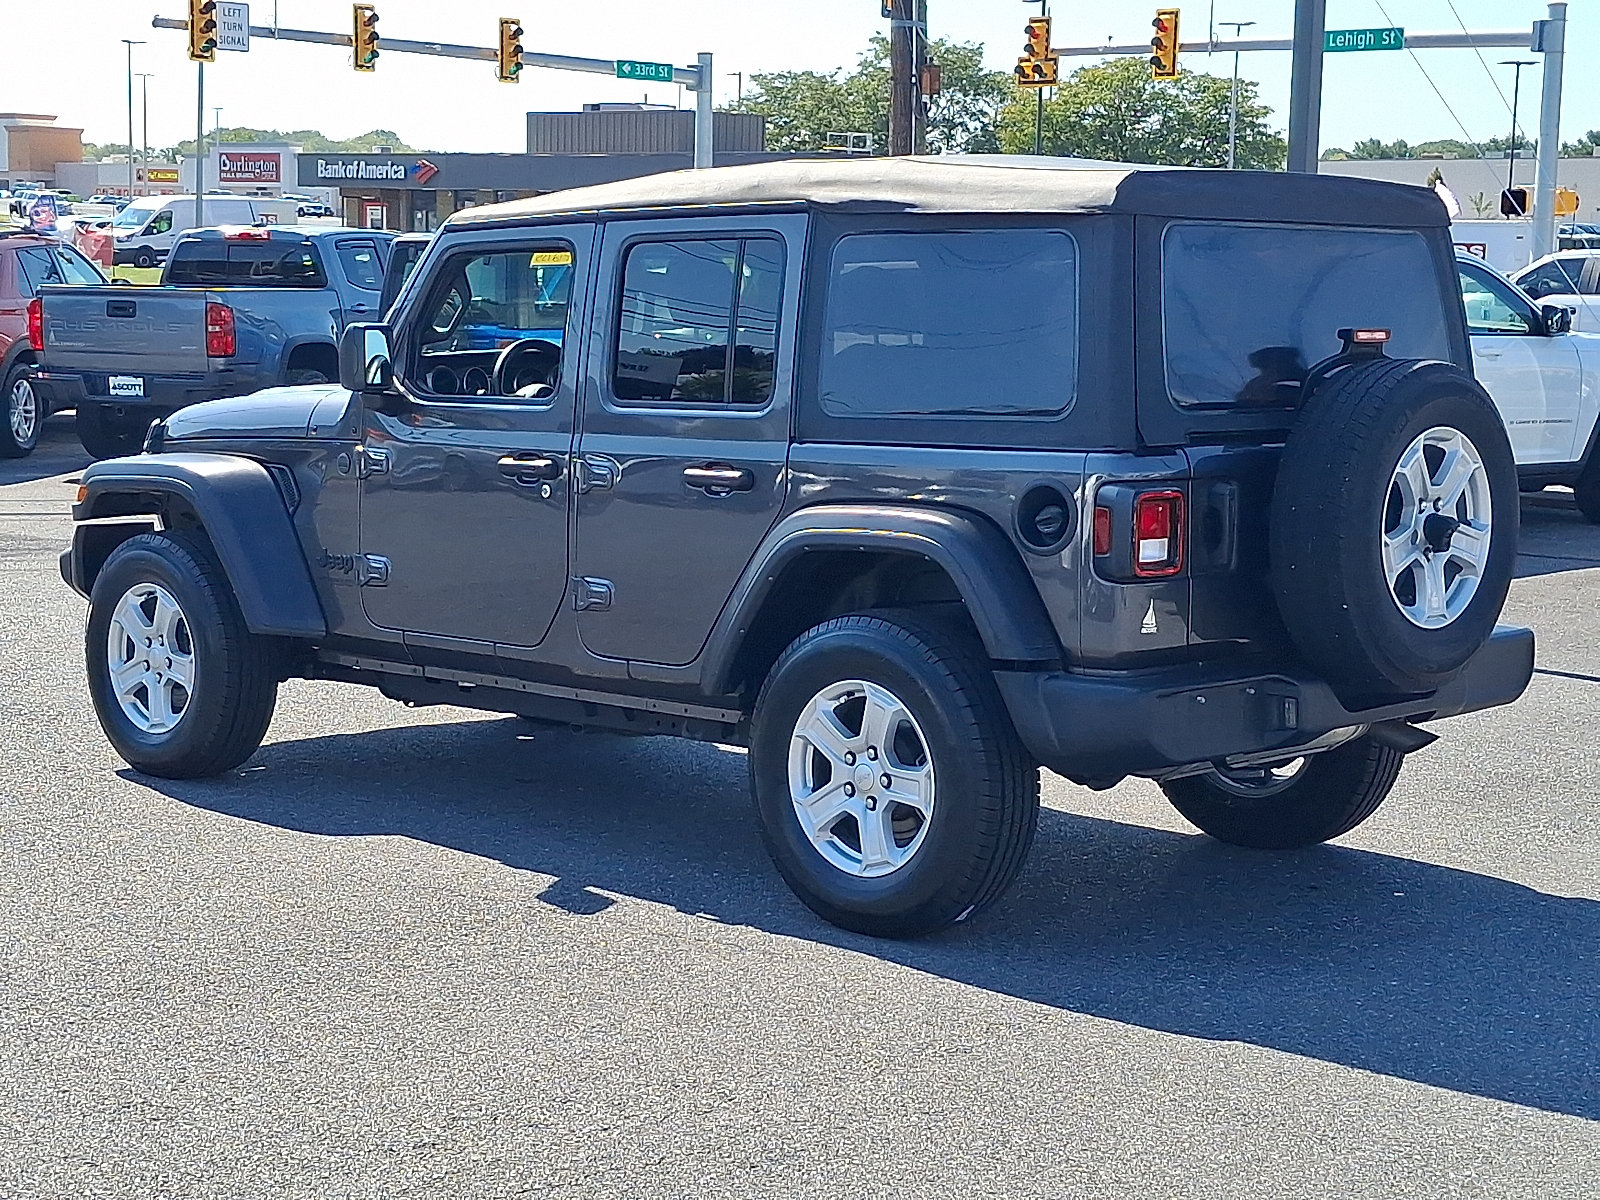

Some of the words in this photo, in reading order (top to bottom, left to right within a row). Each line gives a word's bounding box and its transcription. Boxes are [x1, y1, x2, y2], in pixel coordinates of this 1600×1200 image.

[222, 7, 241, 17] LEFT
[223, 21, 243, 31] TURN
[219, 35, 246, 46] SIGNAL
[1329, 31, 1374, 49] Lehigh
[1382, 30, 1395, 44] St
[634, 63, 656, 76] 33rd
[658, 65, 668, 77] St
[220, 154, 277, 176] Burlington
[317, 159, 346, 178] Bank
[346, 160, 358, 178] of
[358, 160, 405, 179] America
[316, 547, 355, 575] Jeep
